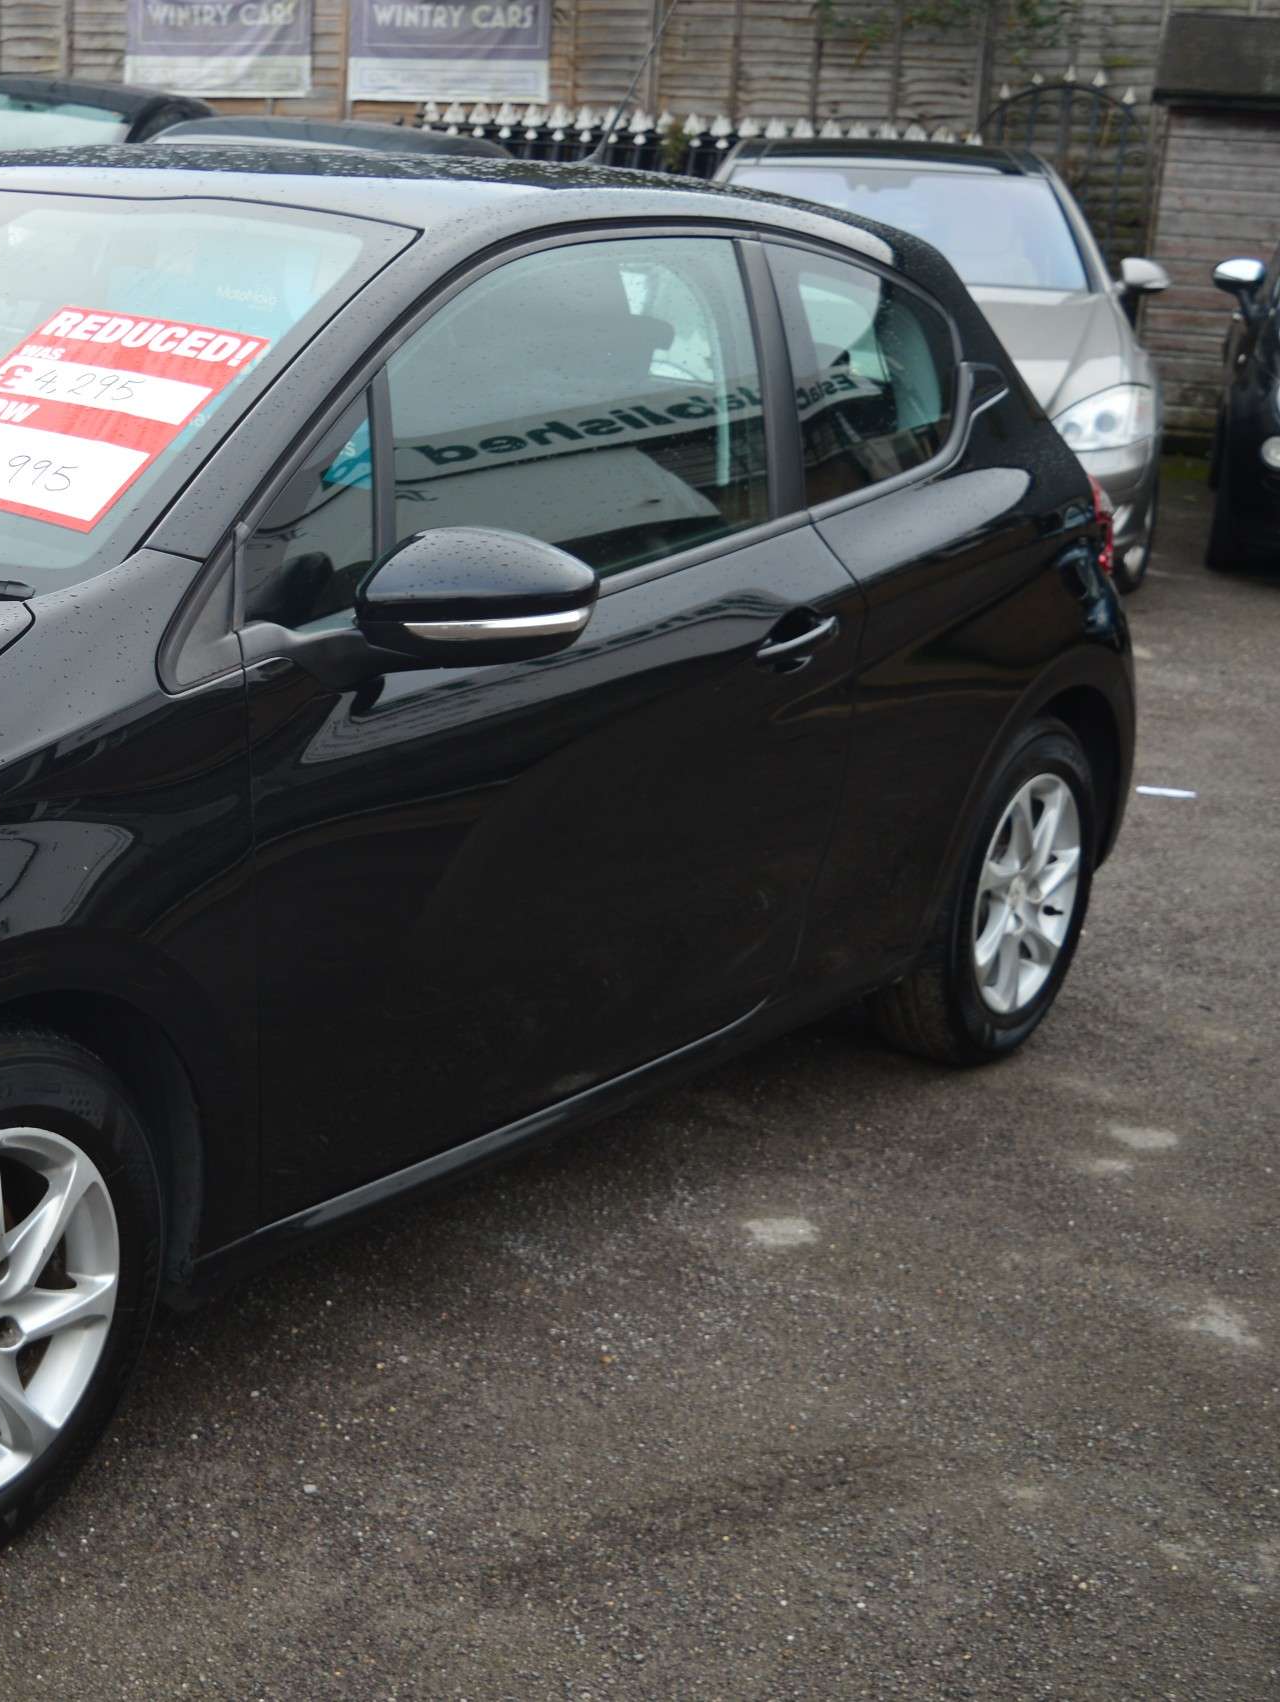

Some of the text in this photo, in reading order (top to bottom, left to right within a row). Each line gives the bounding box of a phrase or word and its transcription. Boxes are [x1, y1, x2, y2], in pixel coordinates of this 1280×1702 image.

[147, 2, 294, 26] WINTRY CARS
[373, 4, 535, 29] WINTRY CARS
[41, 311, 253, 367] REDUCED!
[20, 344, 66, 361] WAS
